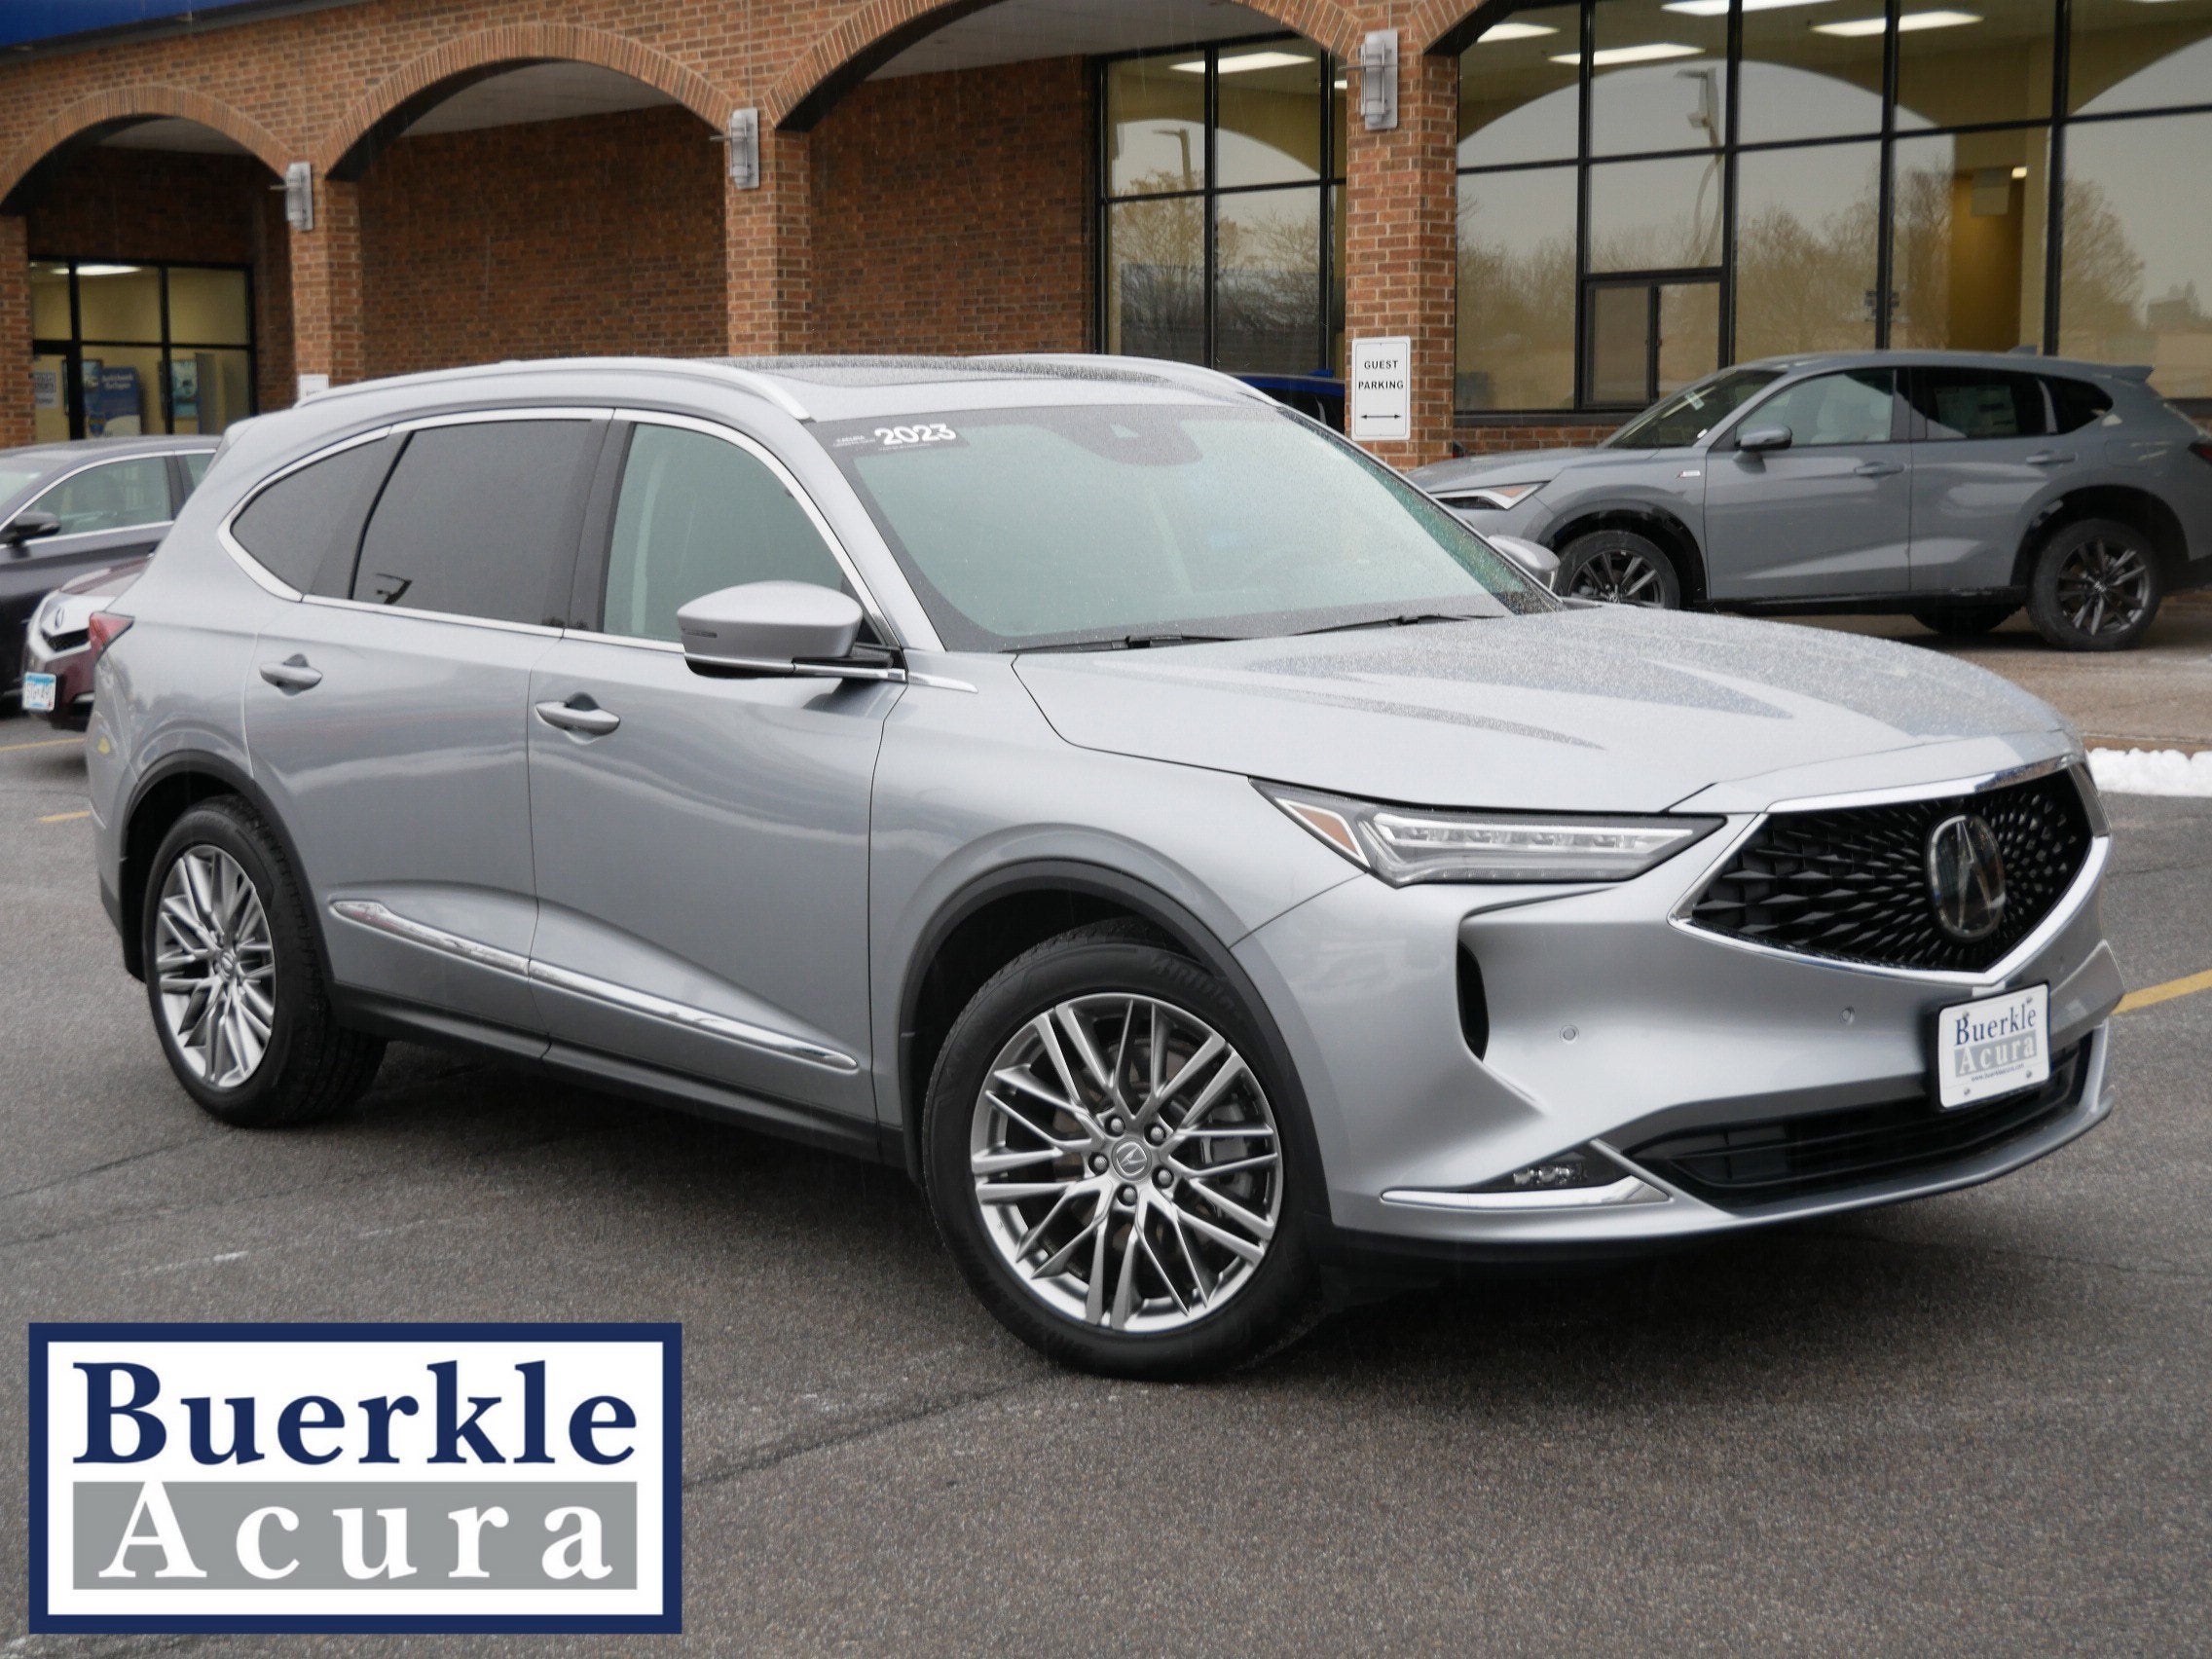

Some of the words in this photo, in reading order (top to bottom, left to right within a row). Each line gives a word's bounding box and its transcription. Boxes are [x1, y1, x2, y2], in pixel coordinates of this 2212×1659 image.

[1364, 360, 1398, 369] GUEST
[1358, 381, 1404, 389] PARKING
[874, 423, 957, 446] 2023
[1955, 1004, 2037, 1046] Buerkle
[1959, 1036, 2035, 1074] Acura
